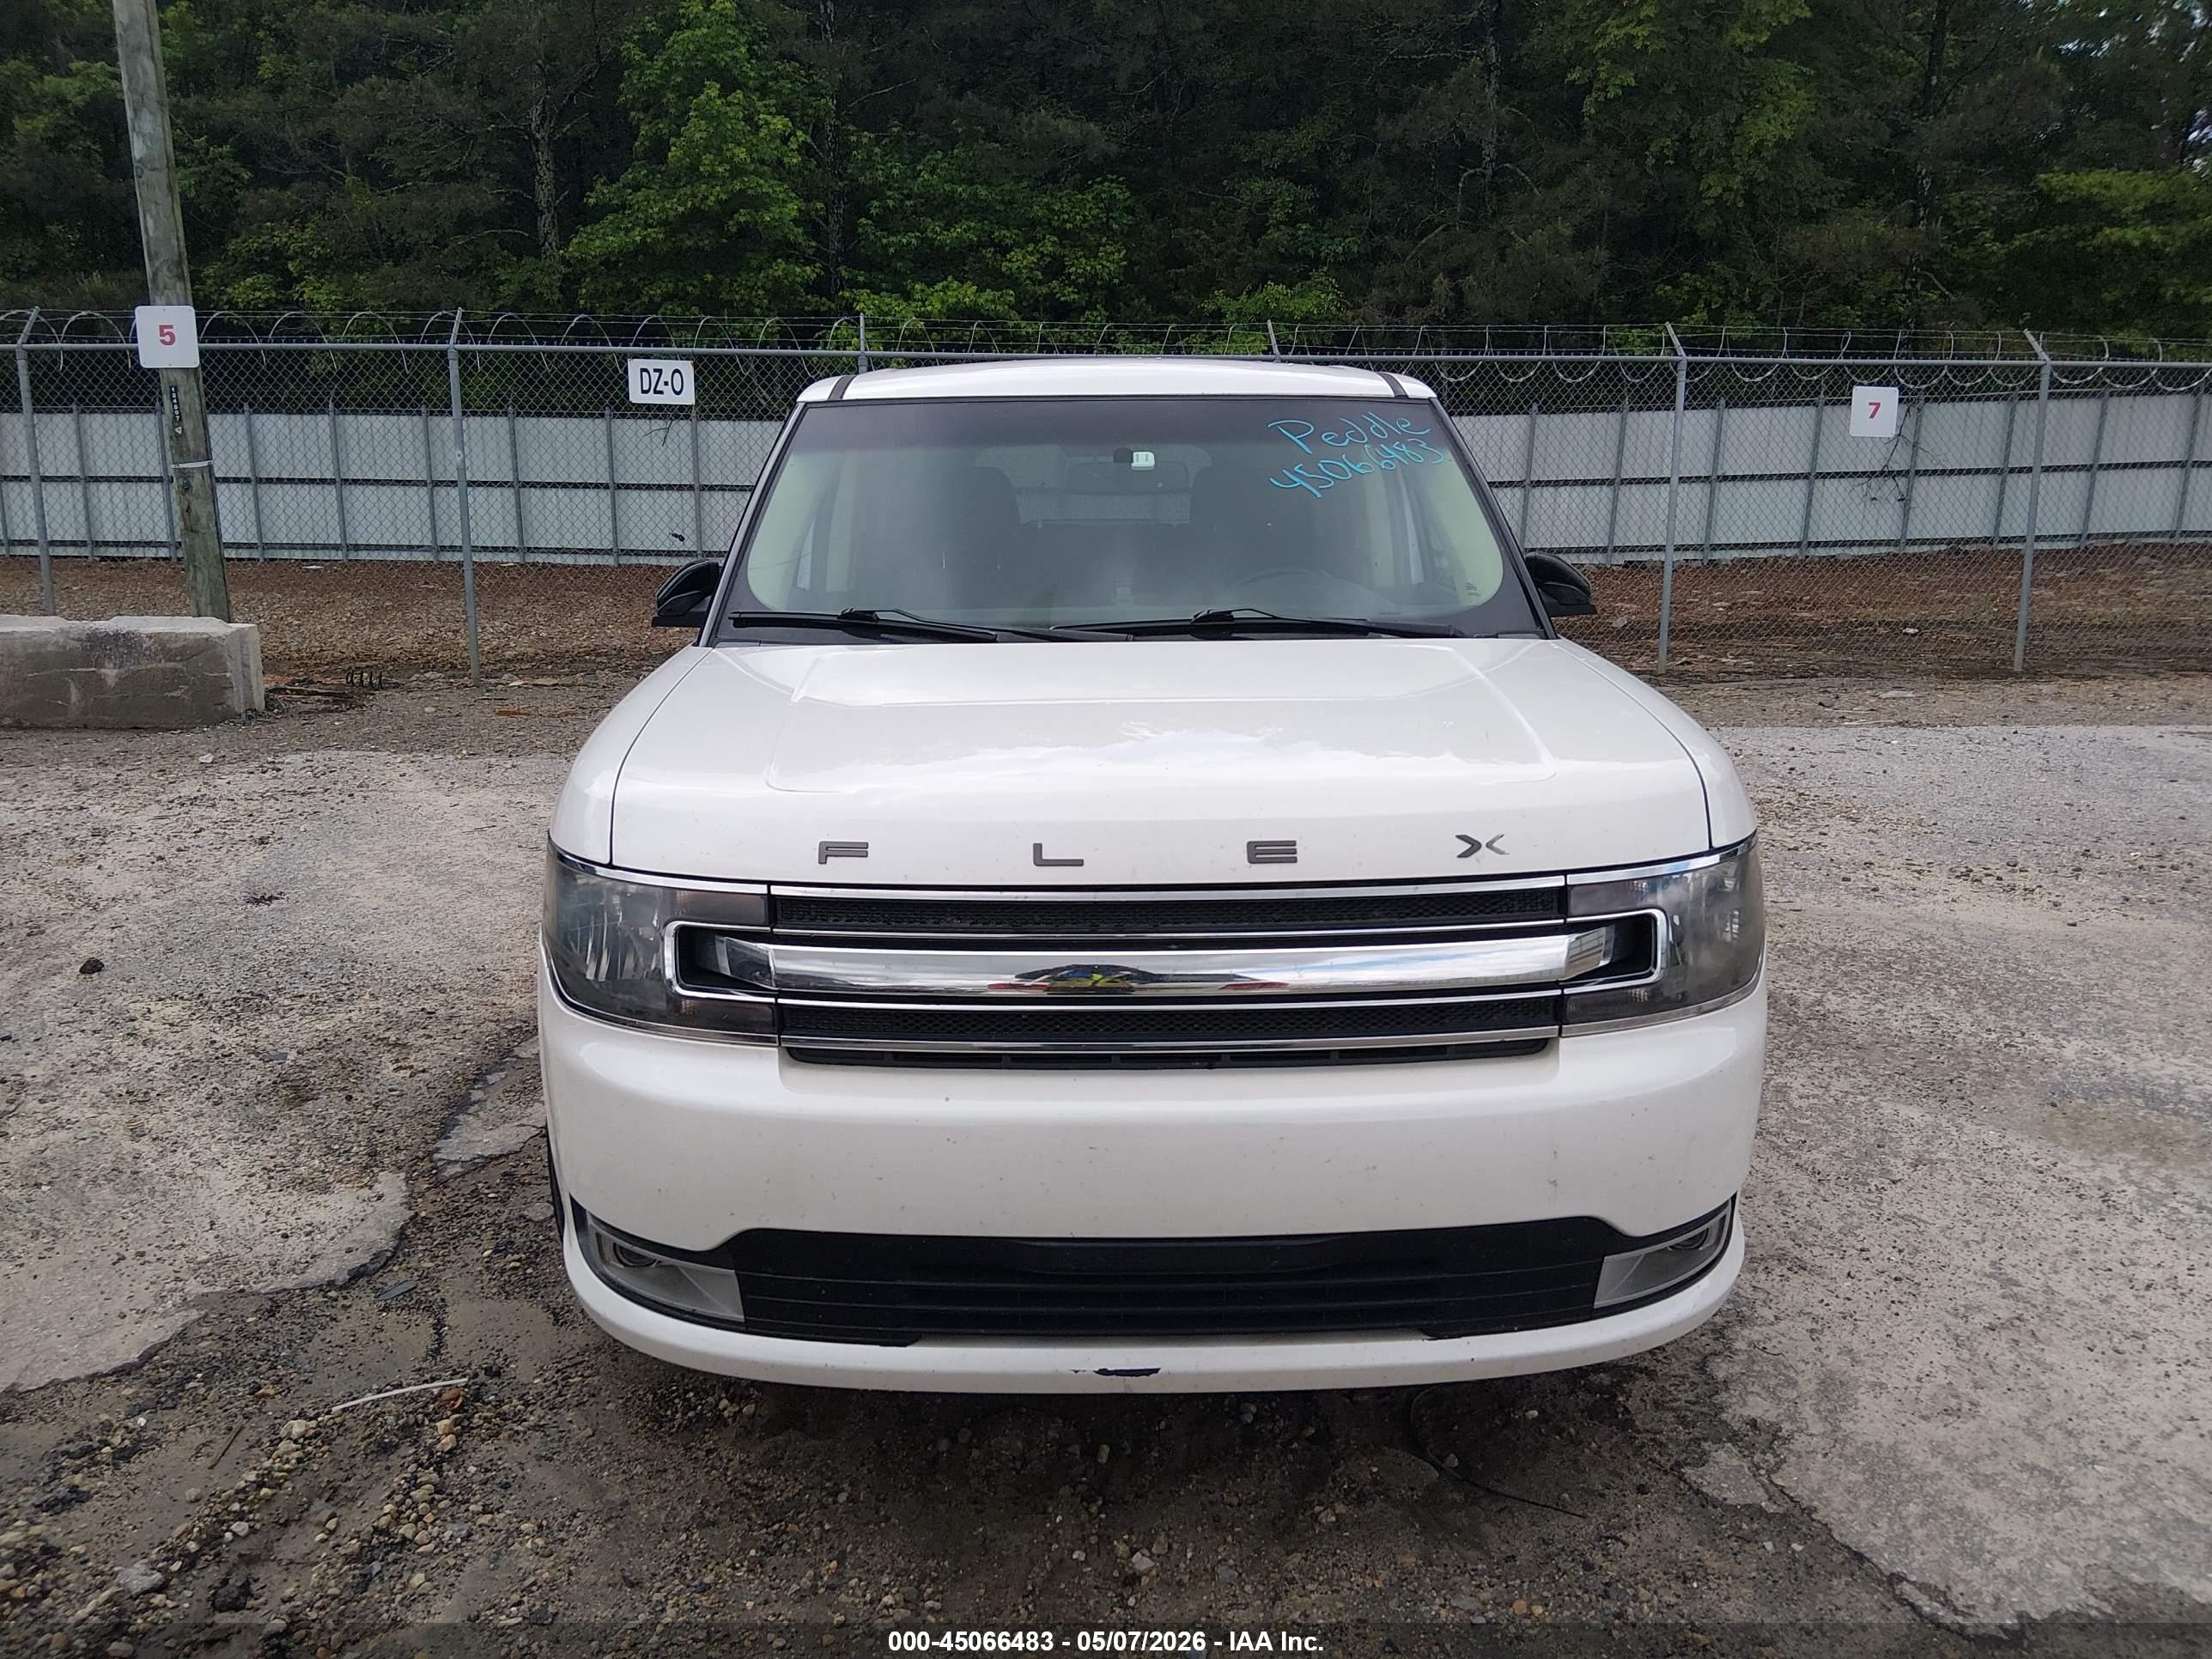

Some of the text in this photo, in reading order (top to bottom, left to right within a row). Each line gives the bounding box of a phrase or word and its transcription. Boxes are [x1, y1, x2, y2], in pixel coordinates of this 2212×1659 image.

[159, 325, 176, 346] 5
[1868, 402, 1881, 419] 7
[1267, 411, 1431, 454] Peddle
[1269, 438, 1444, 498] 45066483
